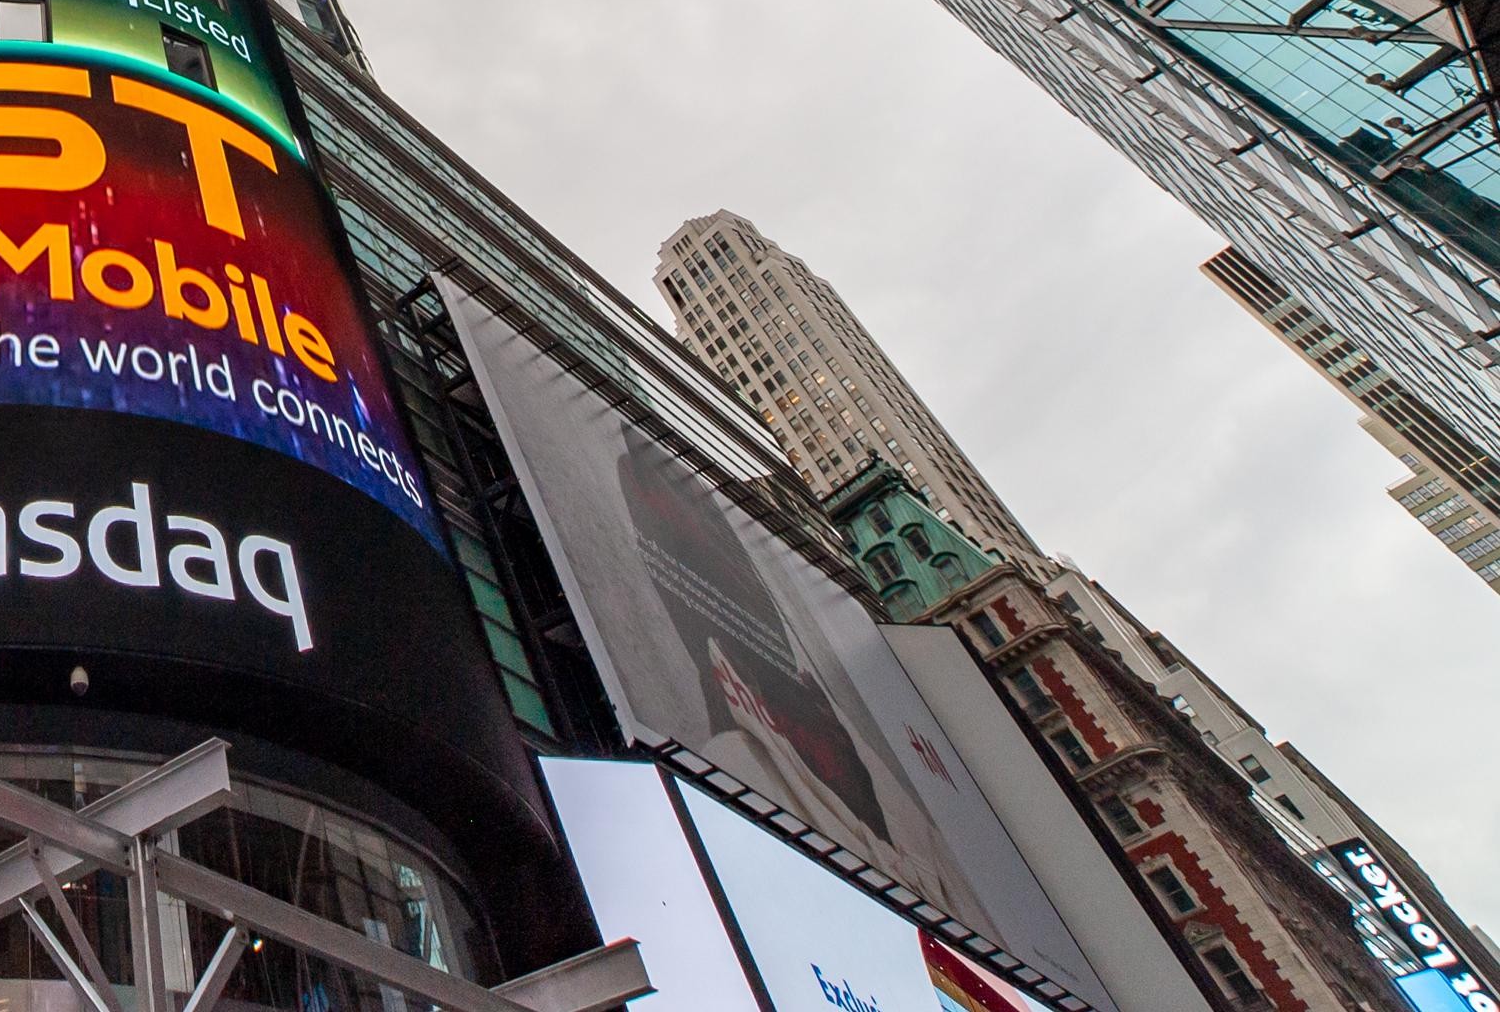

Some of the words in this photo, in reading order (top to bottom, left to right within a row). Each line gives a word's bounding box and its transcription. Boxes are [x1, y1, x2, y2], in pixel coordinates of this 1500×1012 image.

[80, 339, 238, 402] world
[252, 379, 422, 508] connects
[810, 962, 882, 1012] Exclu
